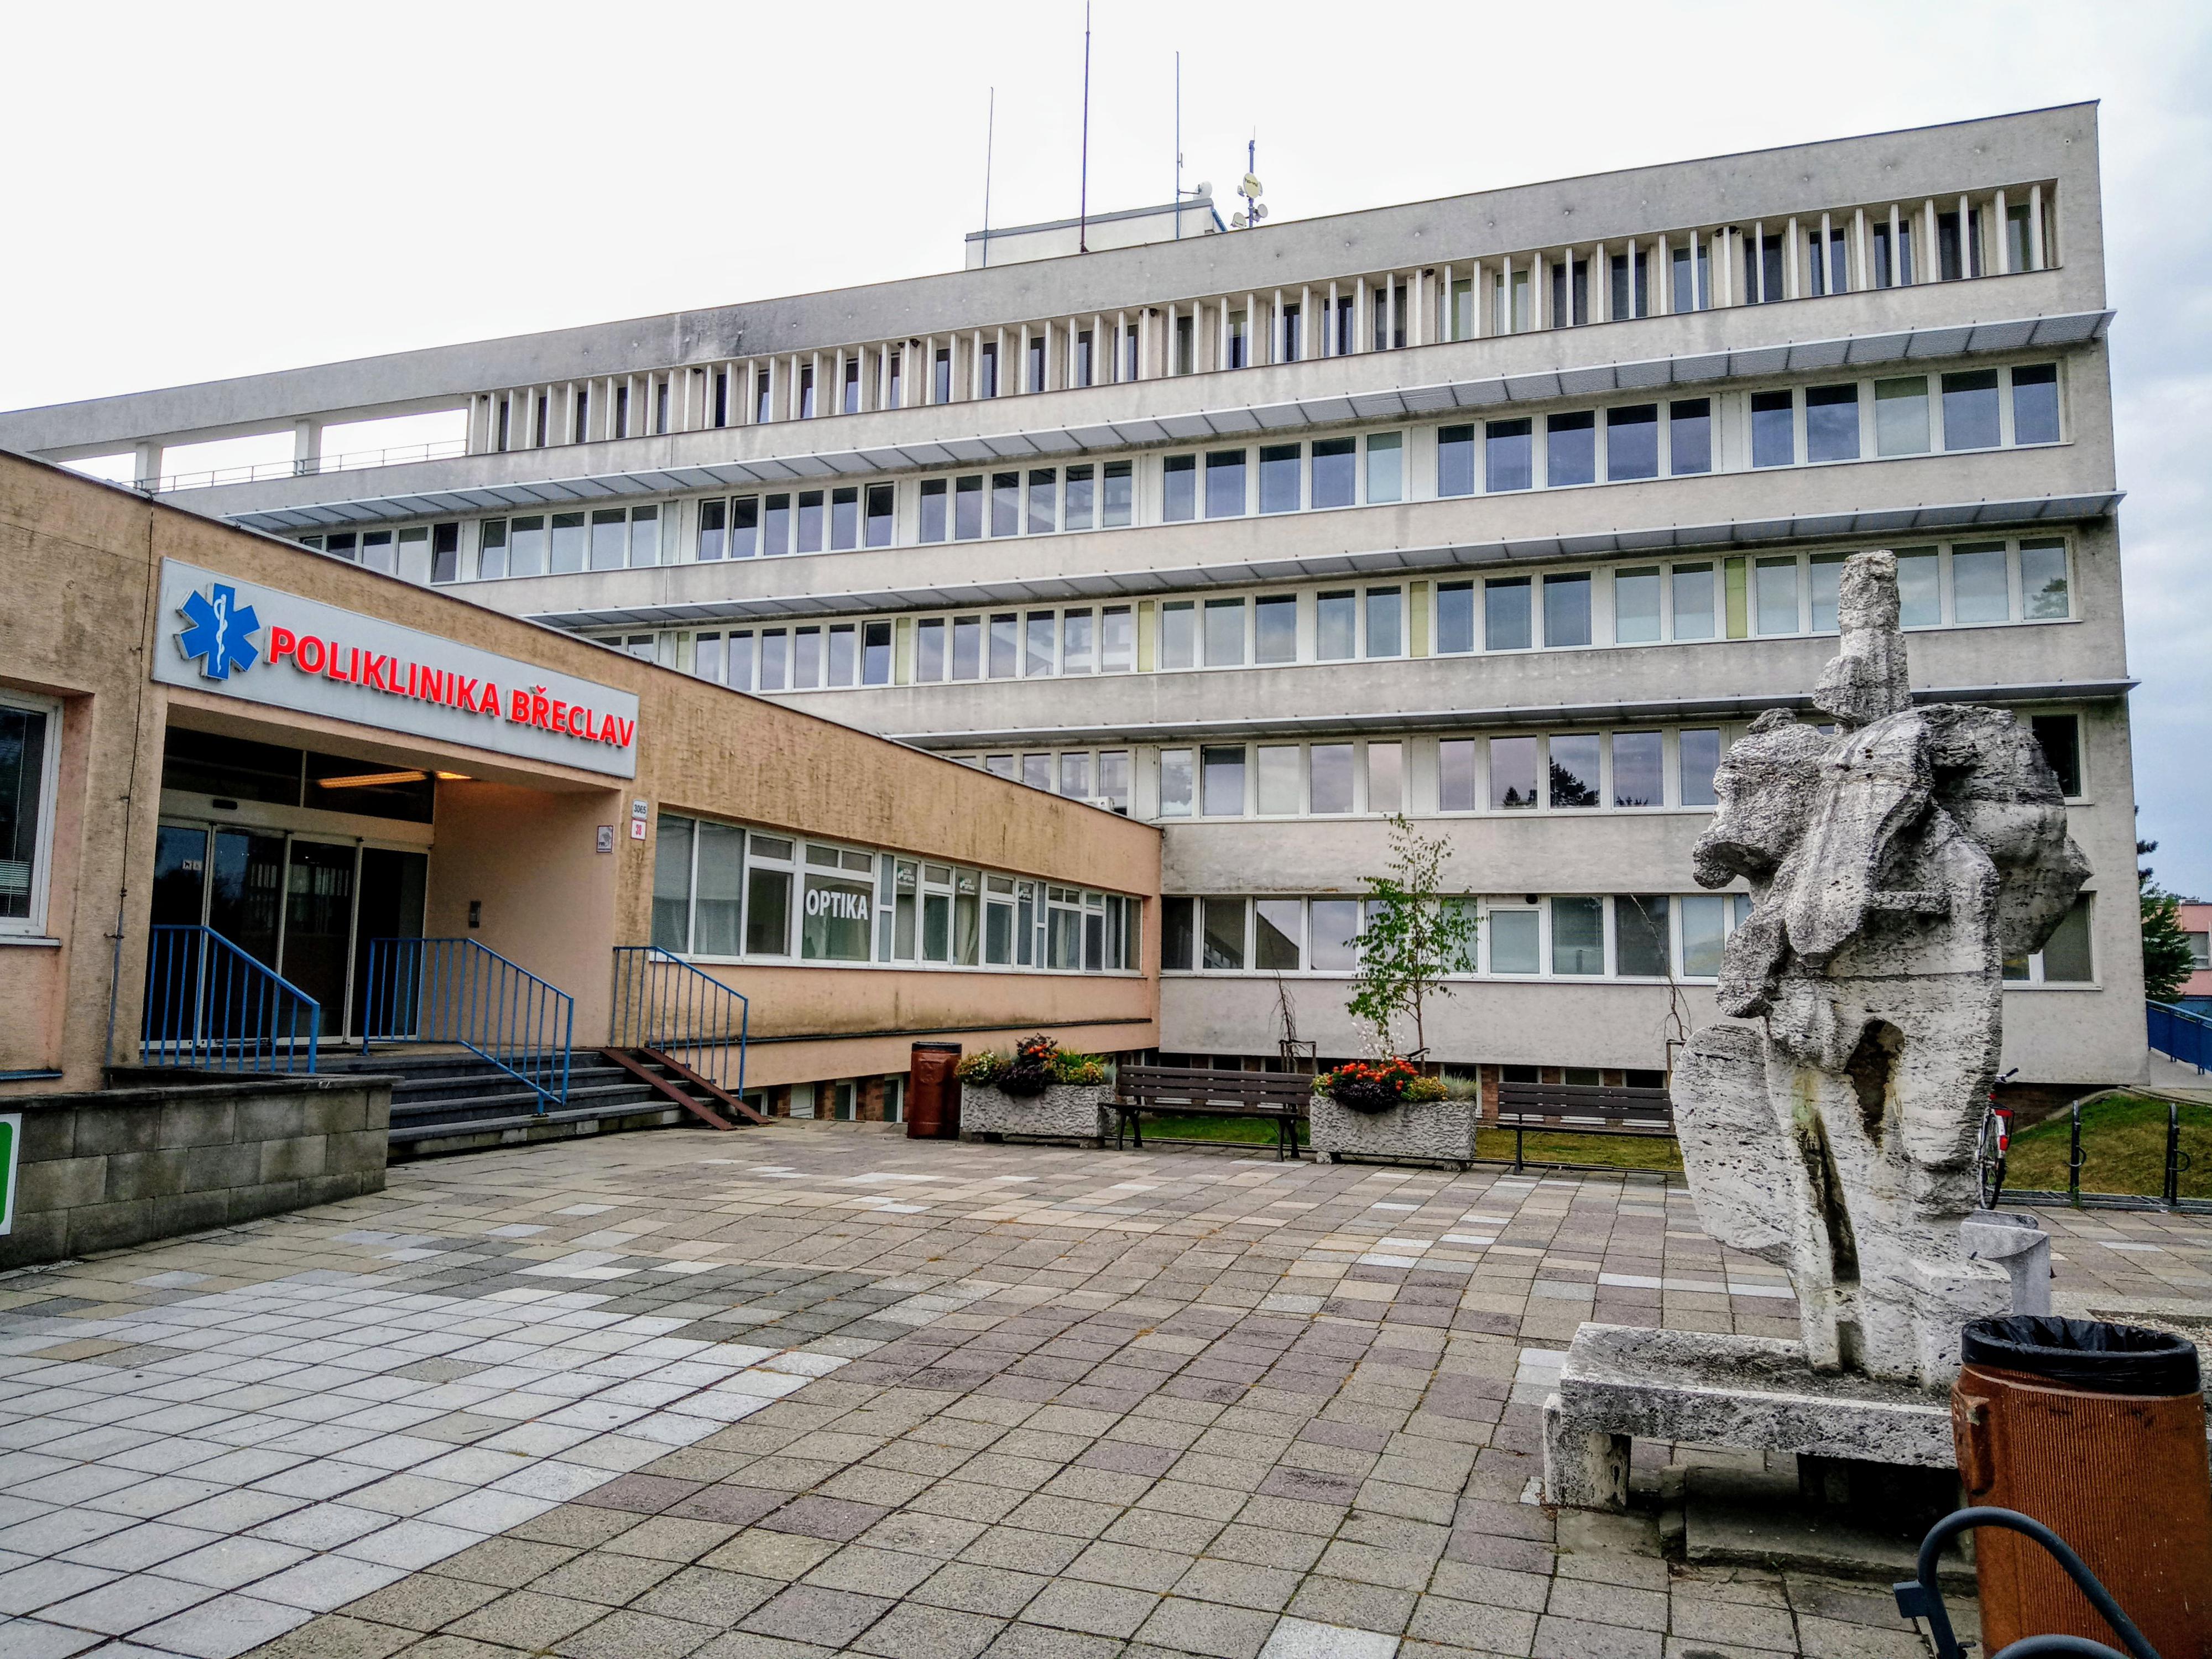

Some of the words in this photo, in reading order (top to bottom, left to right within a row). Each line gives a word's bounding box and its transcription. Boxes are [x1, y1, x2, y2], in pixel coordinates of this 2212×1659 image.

[269, 625, 500, 716] POLIKLINIKA
[511, 685, 634, 747] BŘECLAV
[634, 804, 646, 815] 3065
[806, 889, 868, 920] OPTIKA
